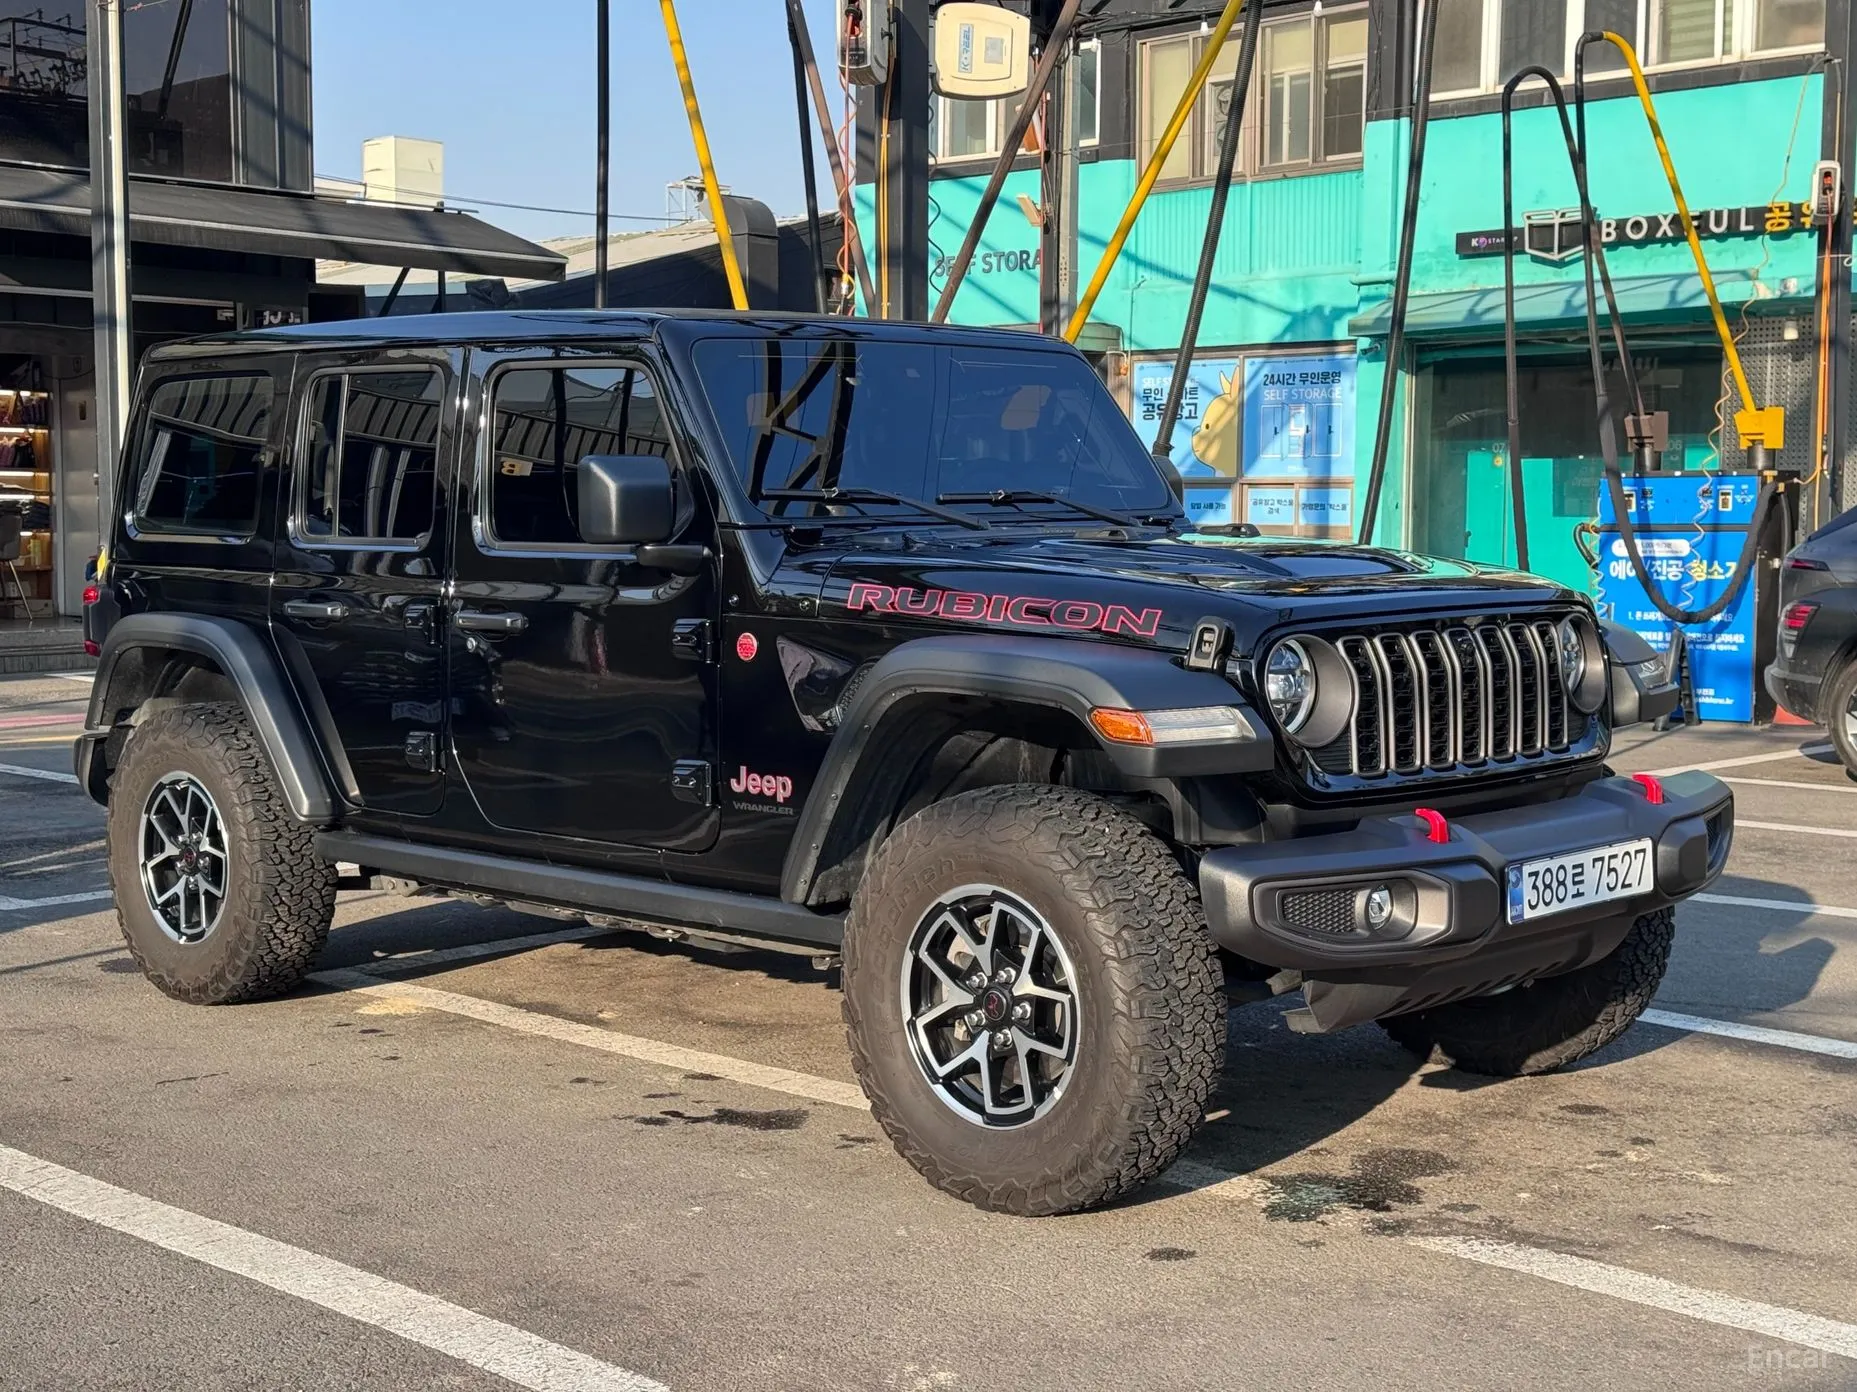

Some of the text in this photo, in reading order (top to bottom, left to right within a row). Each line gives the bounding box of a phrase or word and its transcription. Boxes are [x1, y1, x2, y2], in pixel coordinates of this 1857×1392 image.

[935, 253, 977, 277] SEF
[1263, 371, 1341, 386] 24시간 무인운영
[1142, 387, 1163, 401] 무인
[1263, 387, 1342, 400] SELF STORAGE
[847, 583, 1162, 636] RUBICON
[730, 765, 792, 803] Jeep
[733, 800, 794, 816] WRANGLER
[1527, 848, 1647, 910] 388로 7527
